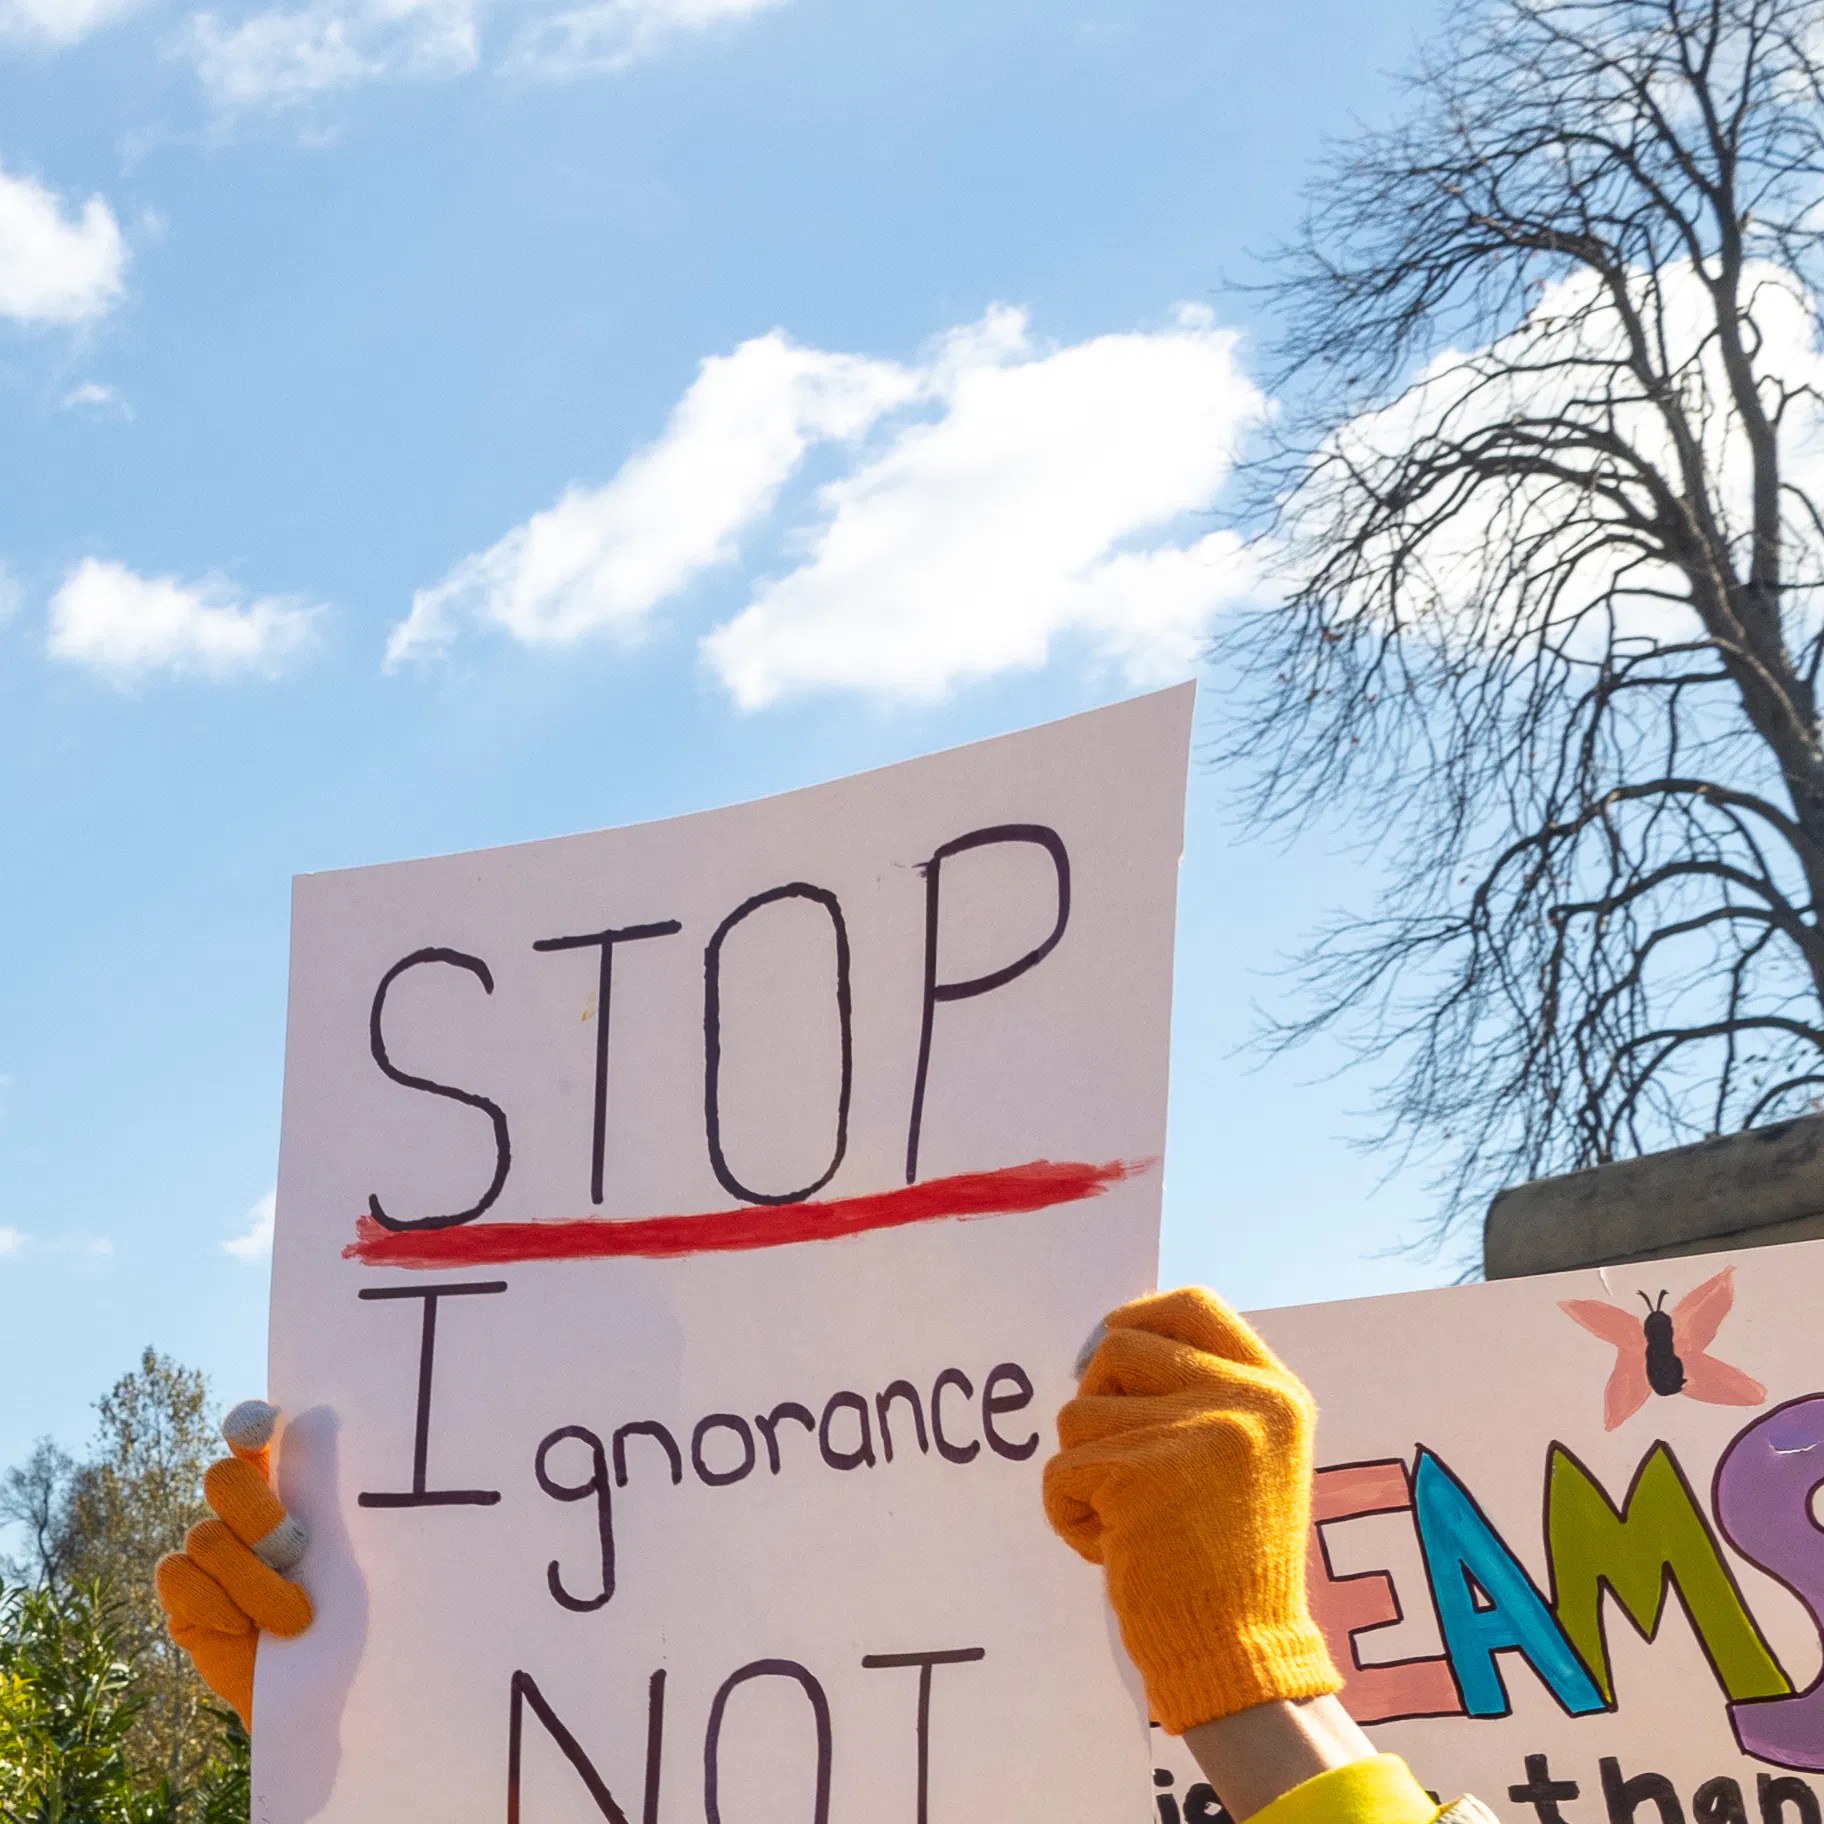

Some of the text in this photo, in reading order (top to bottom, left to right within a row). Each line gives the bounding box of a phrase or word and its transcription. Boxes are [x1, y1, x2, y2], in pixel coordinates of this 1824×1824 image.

[369, 822, 1071, 1232] STOP
[357, 1281, 1041, 1611] Ignorance
[1304, 1391, 1824, 1774] EAMS
